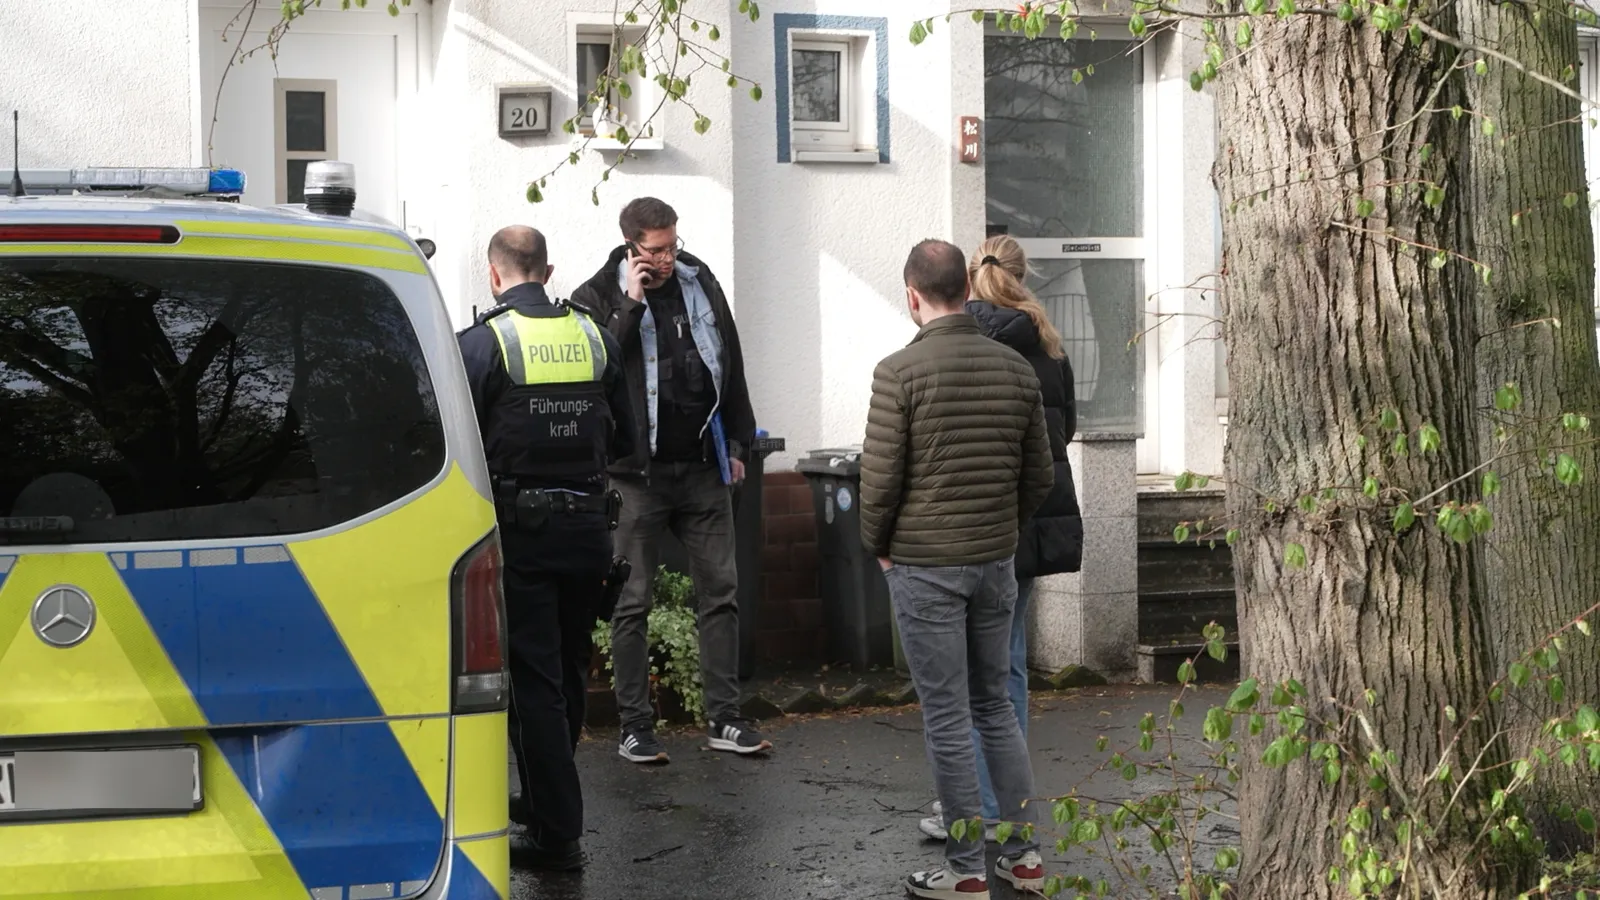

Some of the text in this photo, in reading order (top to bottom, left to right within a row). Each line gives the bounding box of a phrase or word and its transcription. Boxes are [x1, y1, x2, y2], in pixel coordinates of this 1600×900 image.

[511, 107, 538, 128] 20
[963, 120, 978, 158] 松川
[528, 343, 587, 364] POLIZEI
[529, 395, 593, 416] Führungs-
[549, 420, 578, 438] kraft
